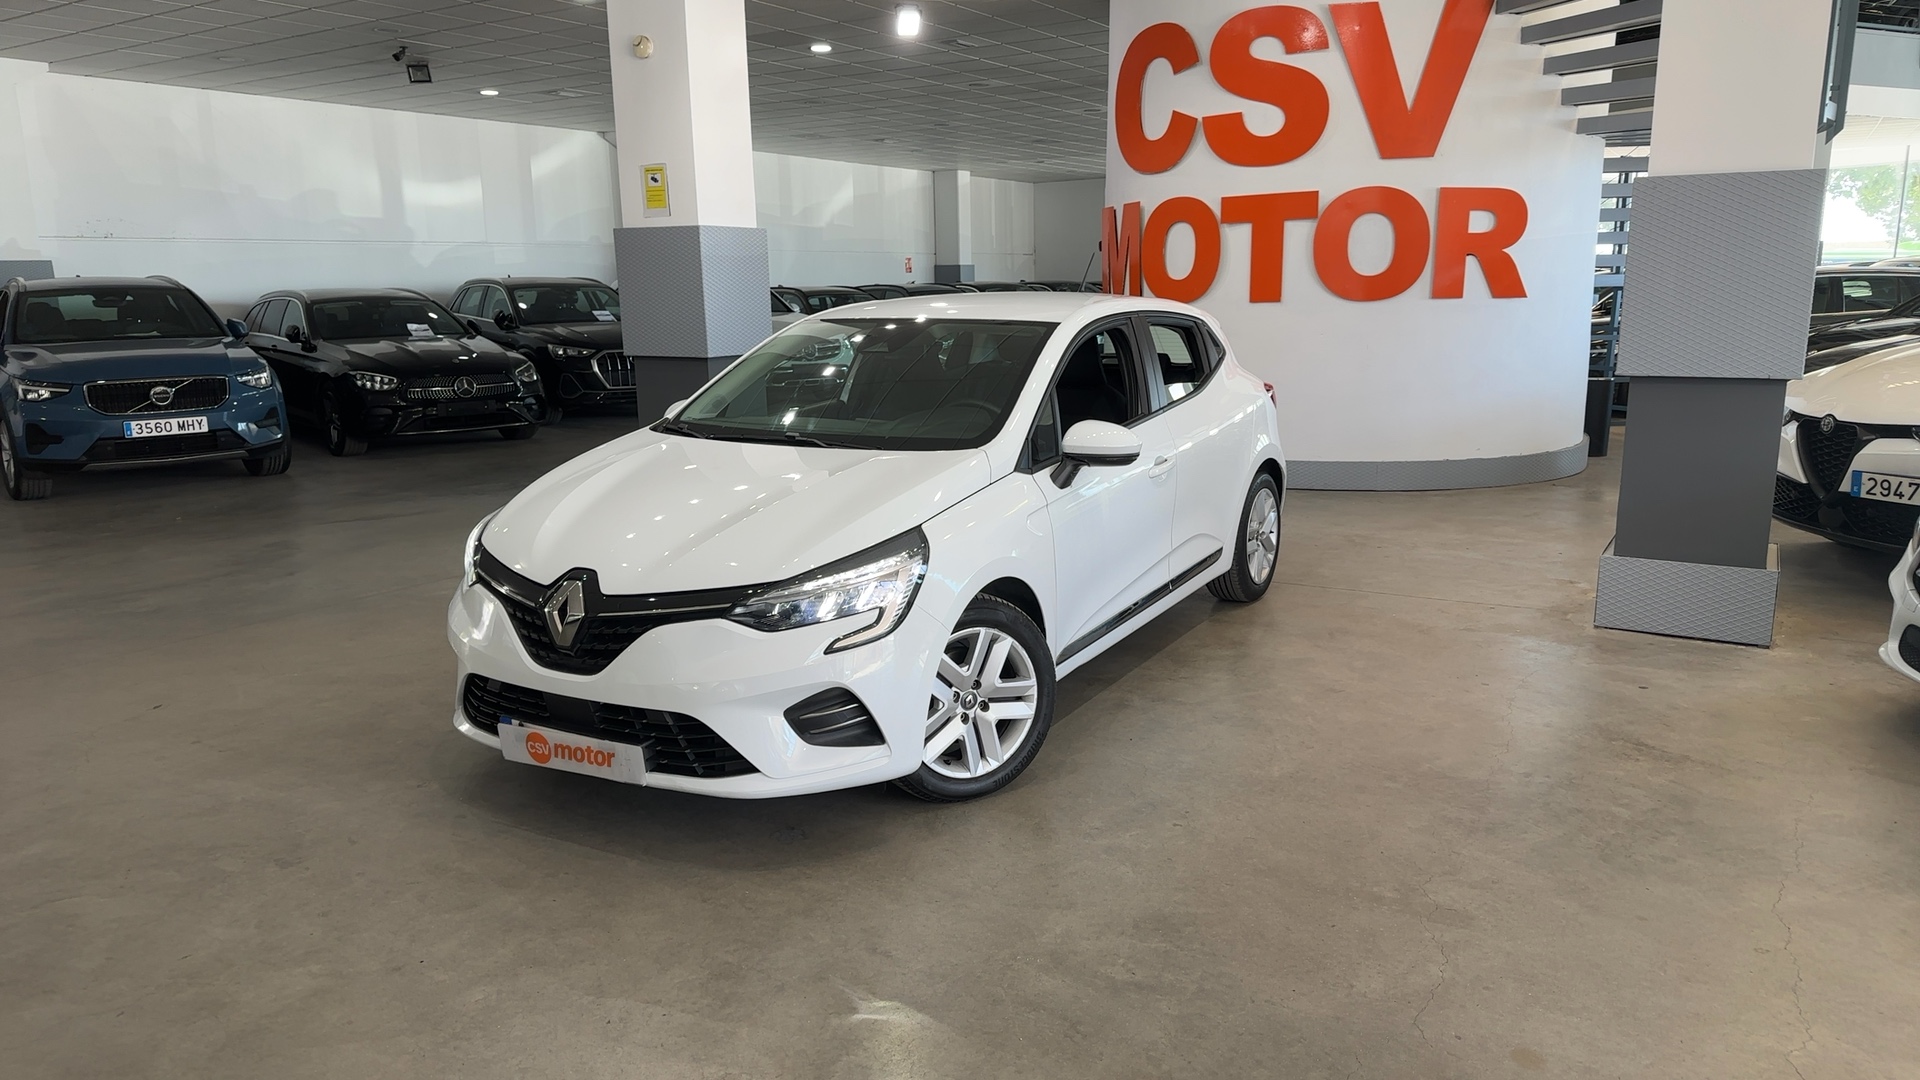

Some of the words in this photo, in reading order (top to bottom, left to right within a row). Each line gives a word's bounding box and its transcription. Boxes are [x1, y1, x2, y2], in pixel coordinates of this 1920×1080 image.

[1115, 0, 1494, 174] CSV
[1102, 186, 1528, 303] MOTOR
[136, 420, 173, 435] 3560
[178, 419, 203, 432] MHY
[1866, 477, 1920, 501] 2947
[527, 742, 550, 756] CSV
[554, 742, 616, 768] motor
